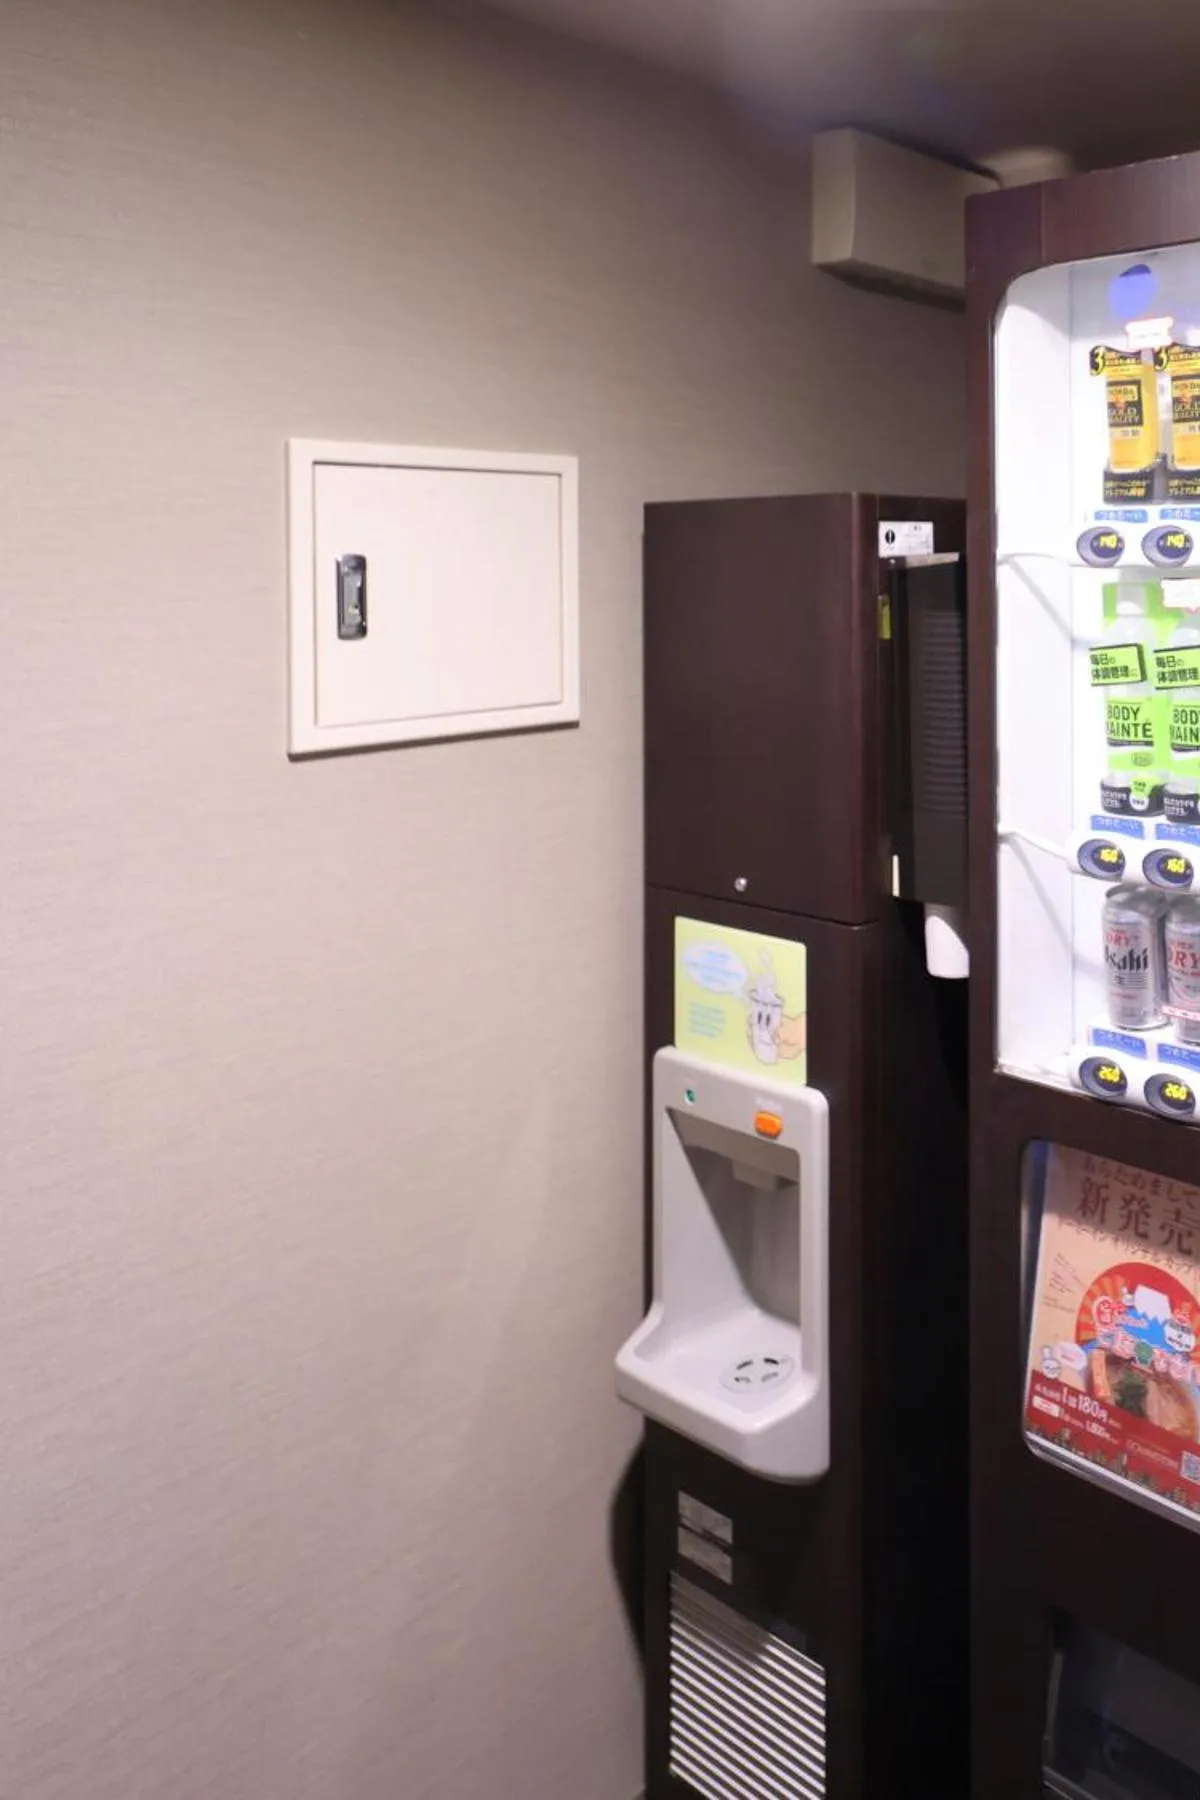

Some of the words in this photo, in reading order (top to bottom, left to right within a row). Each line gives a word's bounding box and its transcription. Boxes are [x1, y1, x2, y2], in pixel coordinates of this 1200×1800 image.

[1090, 345, 1105, 376] 3
[1154, 347, 1169, 371] 3
[1107, 719, 1153, 738] AINTÉ
